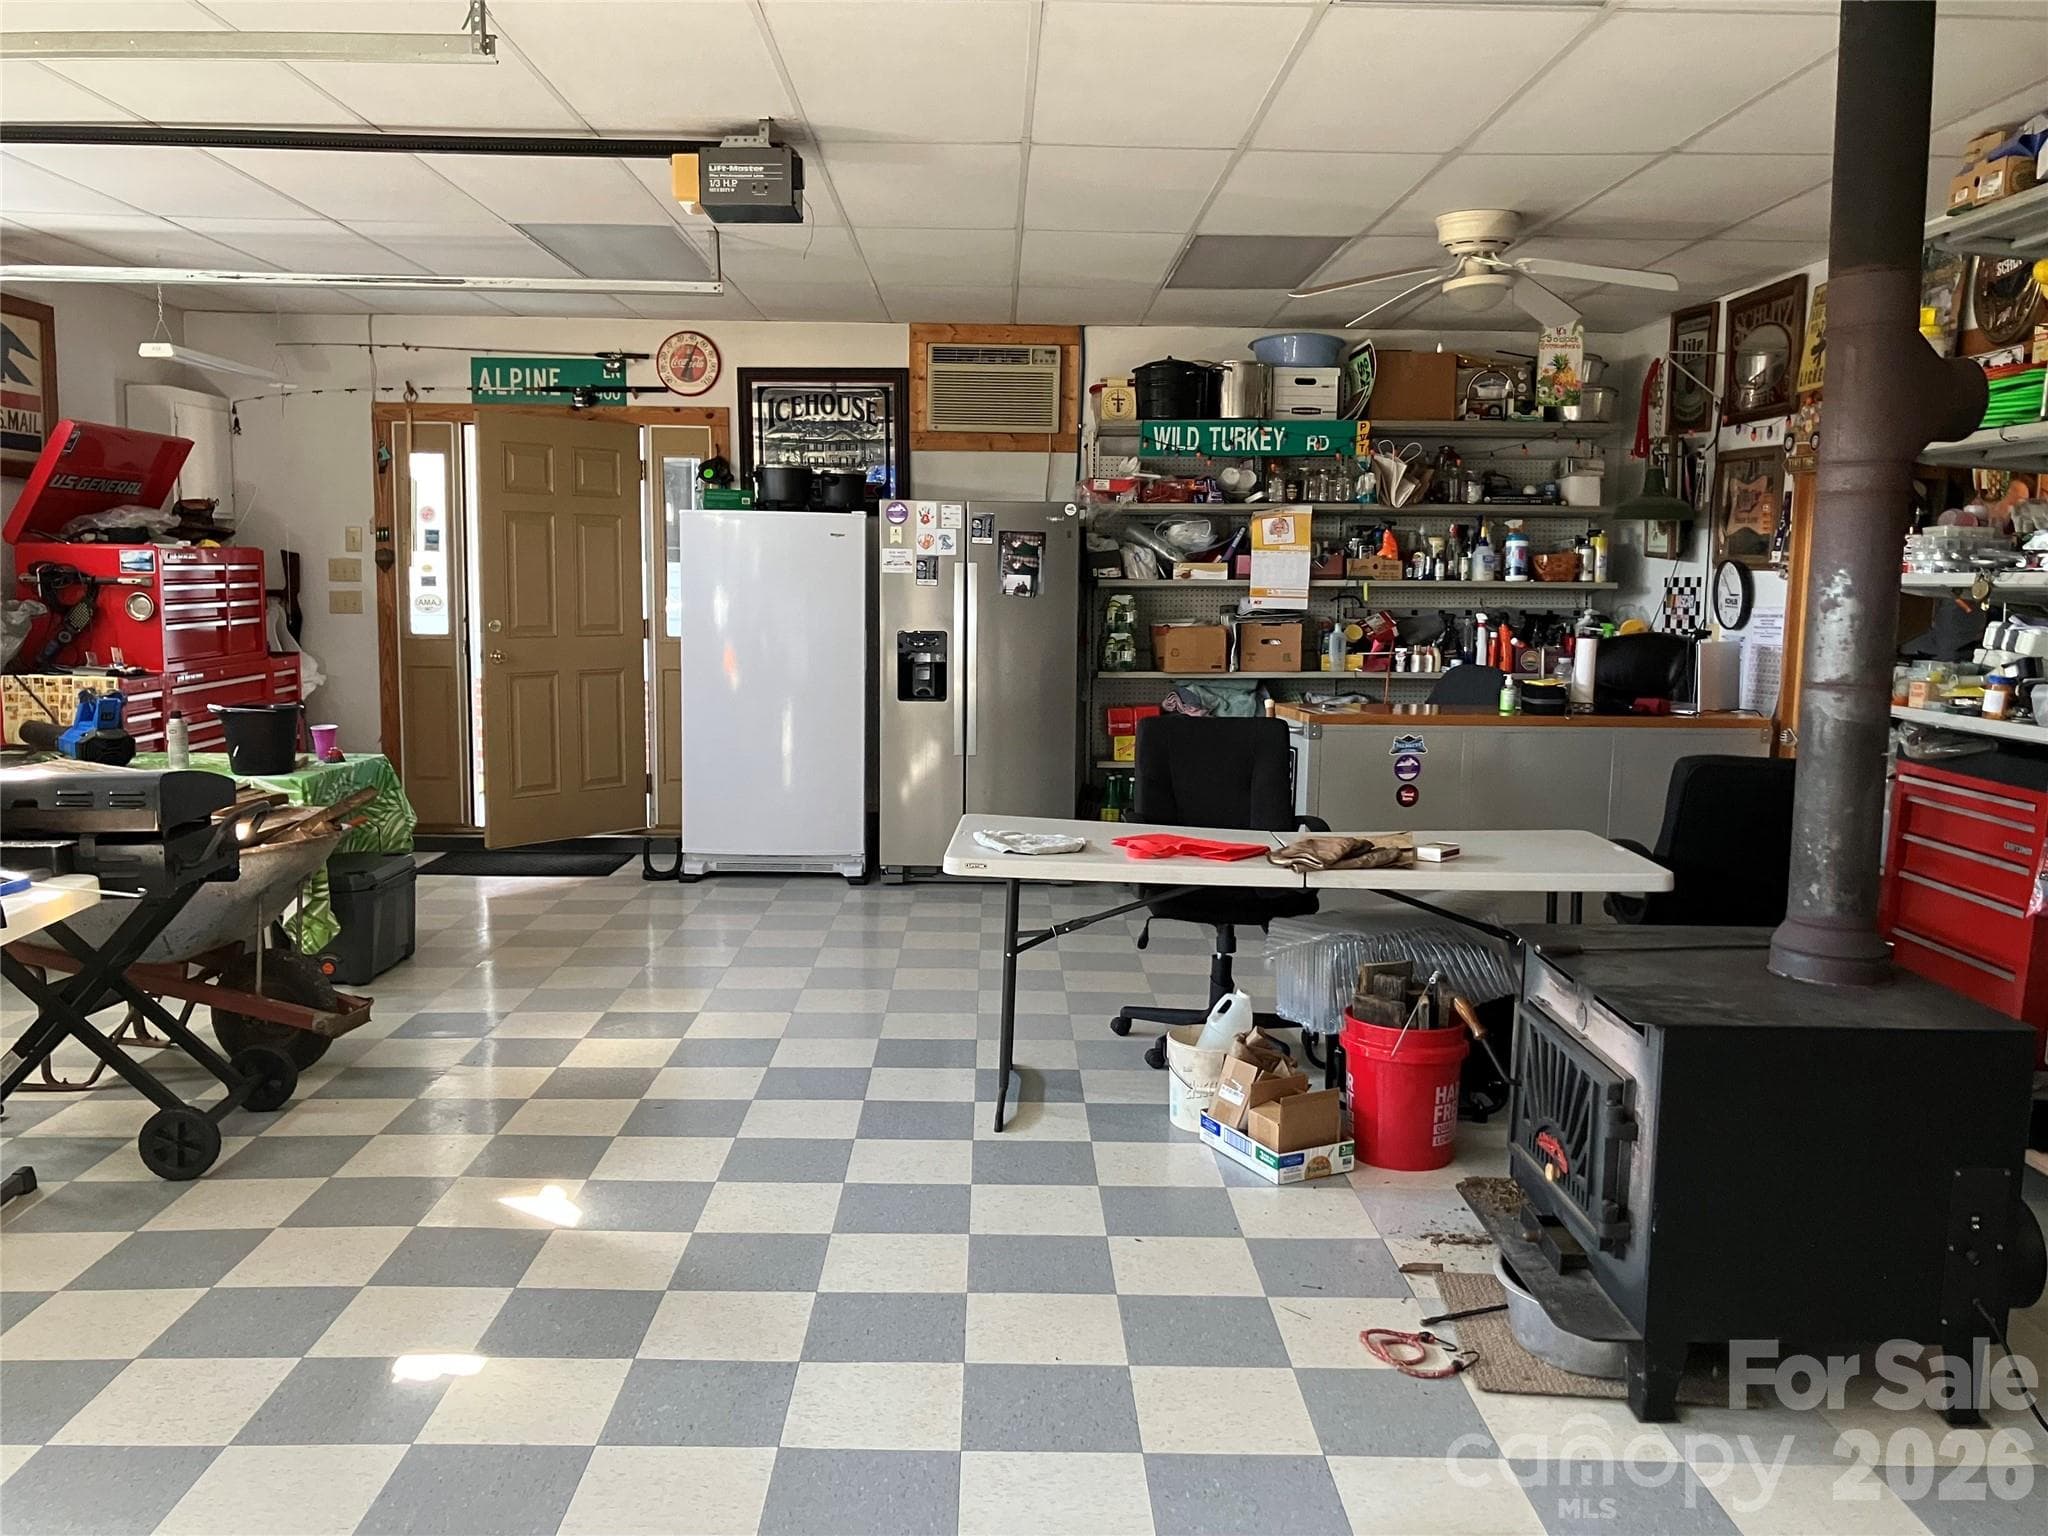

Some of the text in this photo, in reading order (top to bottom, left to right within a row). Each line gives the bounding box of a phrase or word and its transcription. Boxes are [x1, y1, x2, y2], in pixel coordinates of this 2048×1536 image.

[709, 179, 721, 188] 1/3
[478, 367, 561, 396] ALPINE
[767, 393, 880, 429] ICEHOUSE
[1153, 426, 1330, 451] WILD TURKEY RD
